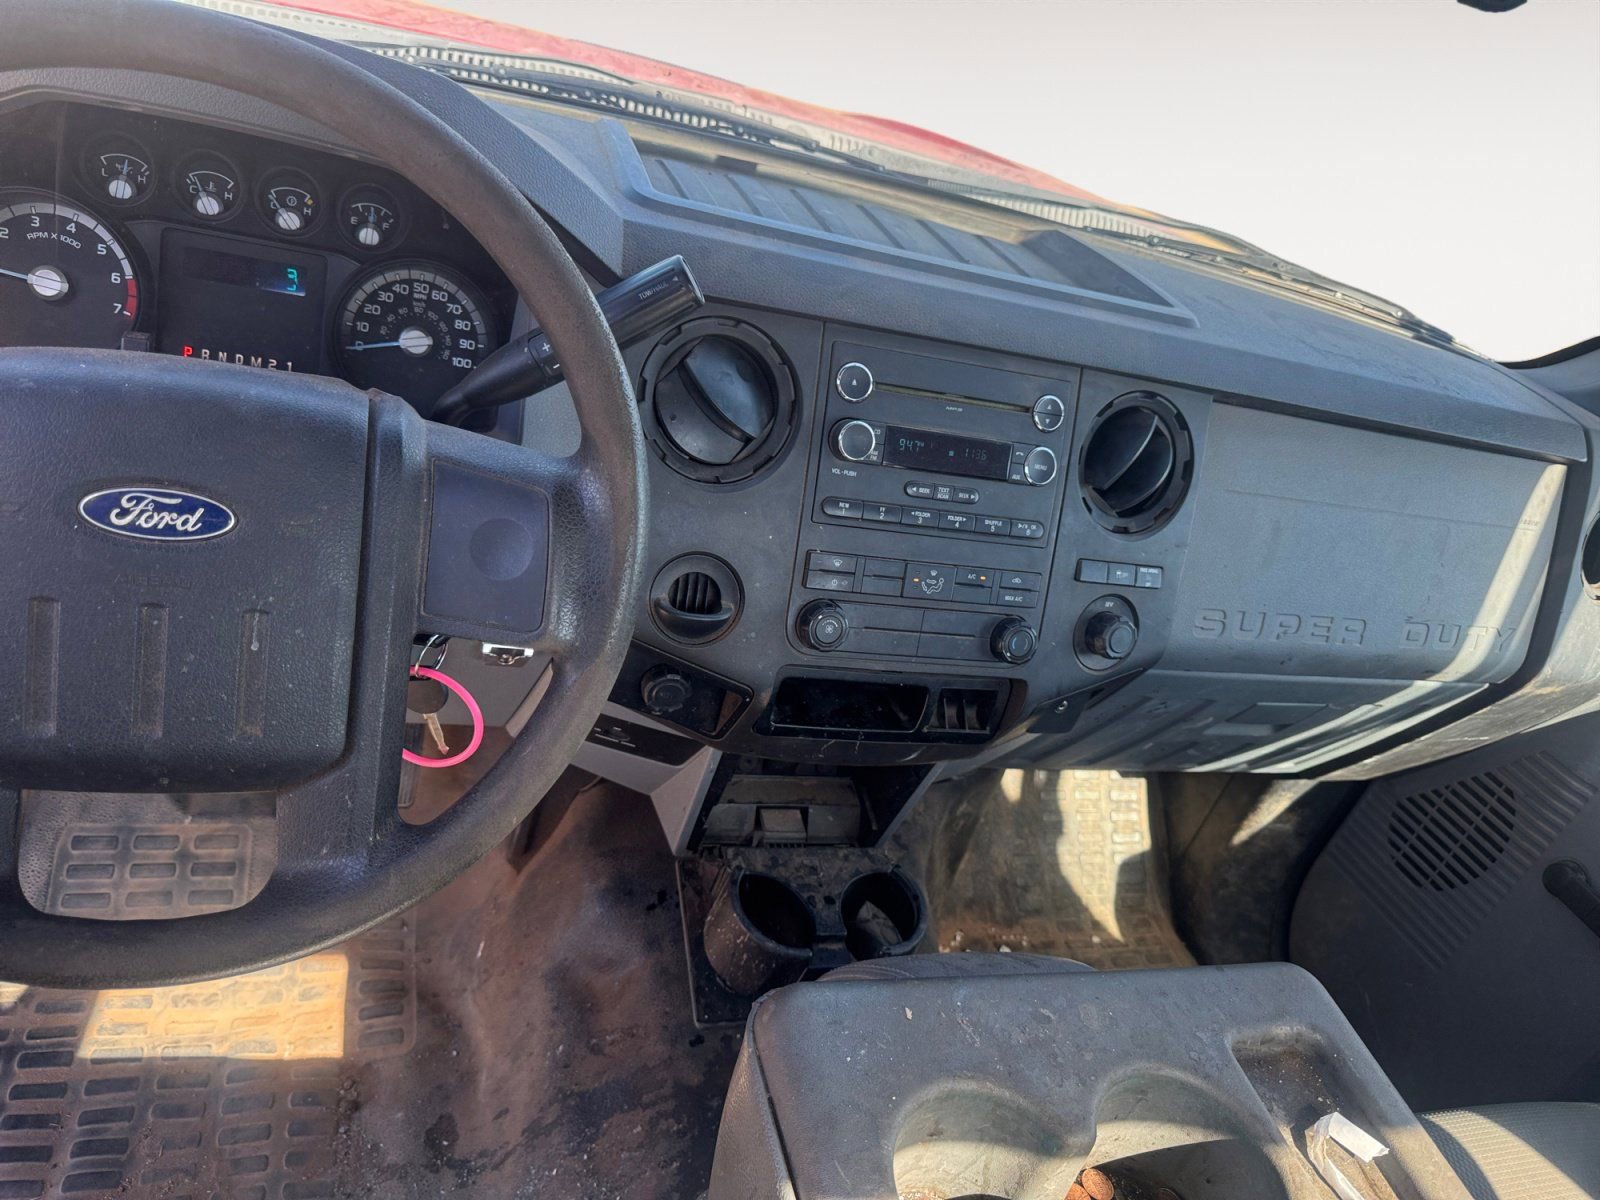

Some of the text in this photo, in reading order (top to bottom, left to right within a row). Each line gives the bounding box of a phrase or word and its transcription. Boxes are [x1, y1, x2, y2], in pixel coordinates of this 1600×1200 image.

[138, 175, 146, 184] H
[224, 191, 233, 200] H
[303, 207, 312, 216] H
[31, 215, 40, 227] 3
[350, 216, 359, 225] E
[0, 226, 9, 239] 2
[66, 222, 77, 233] 4
[26, 232, 49, 240] RPM
[60, 234, 82, 249] 1000
[97, 244, 107, 255] 5
[111, 272, 121, 284] 6
[392, 284, 409, 295] 40
[413, 282, 430, 294] 50
[377, 291, 394, 303] 30
[431, 290, 448, 302] 60
[113, 302, 122, 314] 7
[363, 304, 381, 315] 20
[446, 303, 462, 315] 70
[356, 322, 370, 333] 10
[454, 319, 471, 331] 80
[459, 338, 476, 350] 90
[183, 346, 293, 373] P R N D M 2 1
[451, 357, 472, 369] 100
[109, 492, 204, 532] Ford
[1194, 608, 1517, 650] SUPER DUTY
